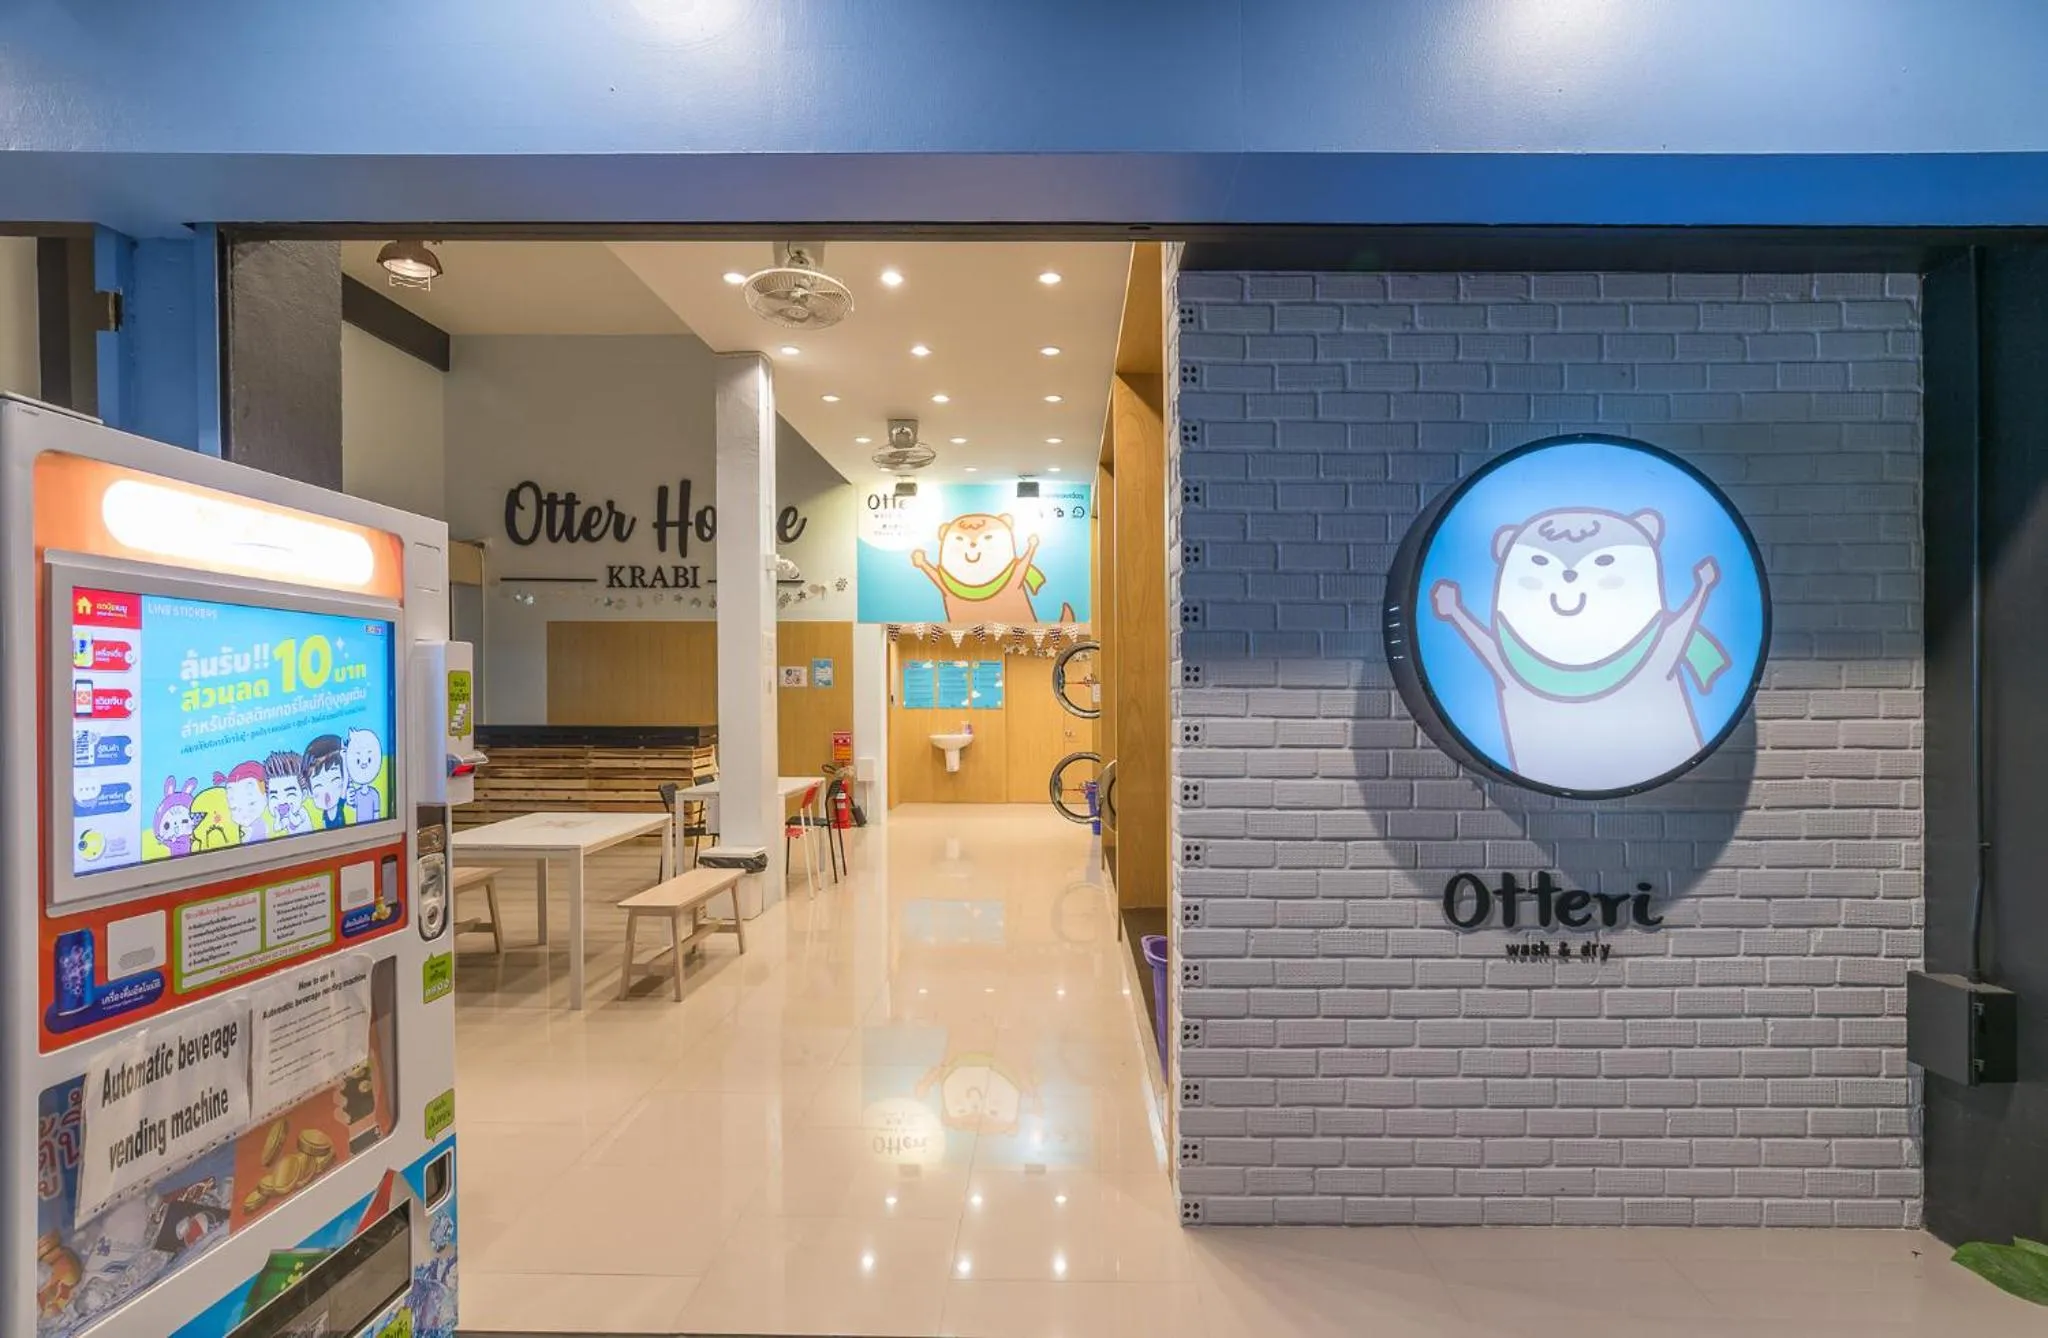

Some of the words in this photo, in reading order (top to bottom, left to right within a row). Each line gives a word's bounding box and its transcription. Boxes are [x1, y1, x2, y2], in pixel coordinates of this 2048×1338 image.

[505, 481, 636, 546] Otter
[652, 479, 807, 559] Hoe
[606, 566, 702, 588] KRABI
[181, 677, 270, 712] ส่วนลด
[272, 634, 333, 693] 10
[333, 663, 367, 683] บาท
[1443, 871, 1664, 928] Otteri
[1505, 941, 1550, 957] wash
[1558, 941, 1571, 957] &
[1581, 941, 1611, 961] dry
[101, 1042, 174, 1108] Automatic
[177, 1021, 238, 1071] beverage
[109, 1117, 168, 1173] vending
[171, 1086, 229, 1140] machine
